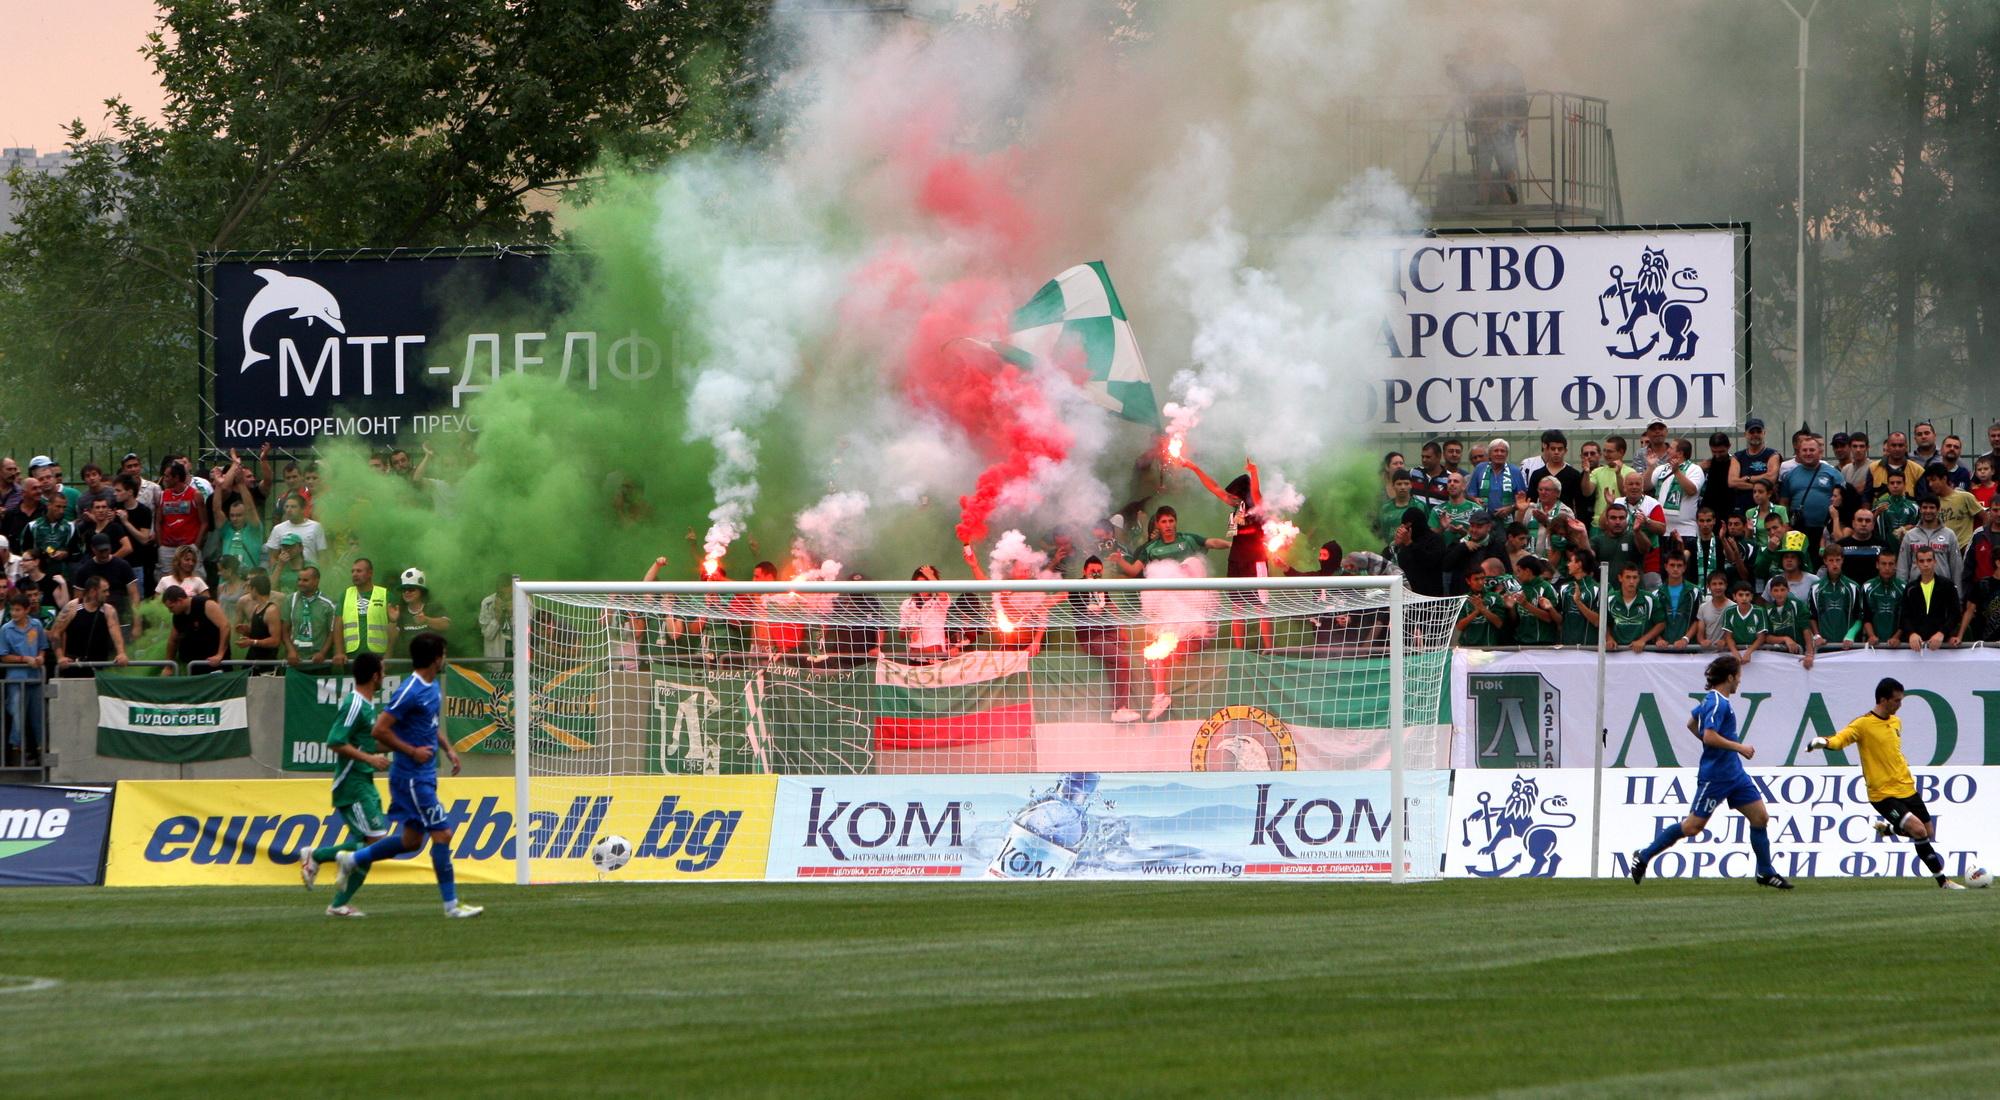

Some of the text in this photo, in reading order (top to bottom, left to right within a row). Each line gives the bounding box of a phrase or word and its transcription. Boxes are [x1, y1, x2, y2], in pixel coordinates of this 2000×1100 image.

[1561, 373, 1725, 421] ФЛОТ
[224, 415, 401, 438] КОРАБОРЕМОНТ
[1475, 680, 1503, 690] ПФК
[134, 713, 216, 726] ЛУДОГОРЕЦ
[1703, 799, 1717, 813] 19
[427, 804, 447, 825] 22
[1141, 862, 1242, 877] www.kom.bg
